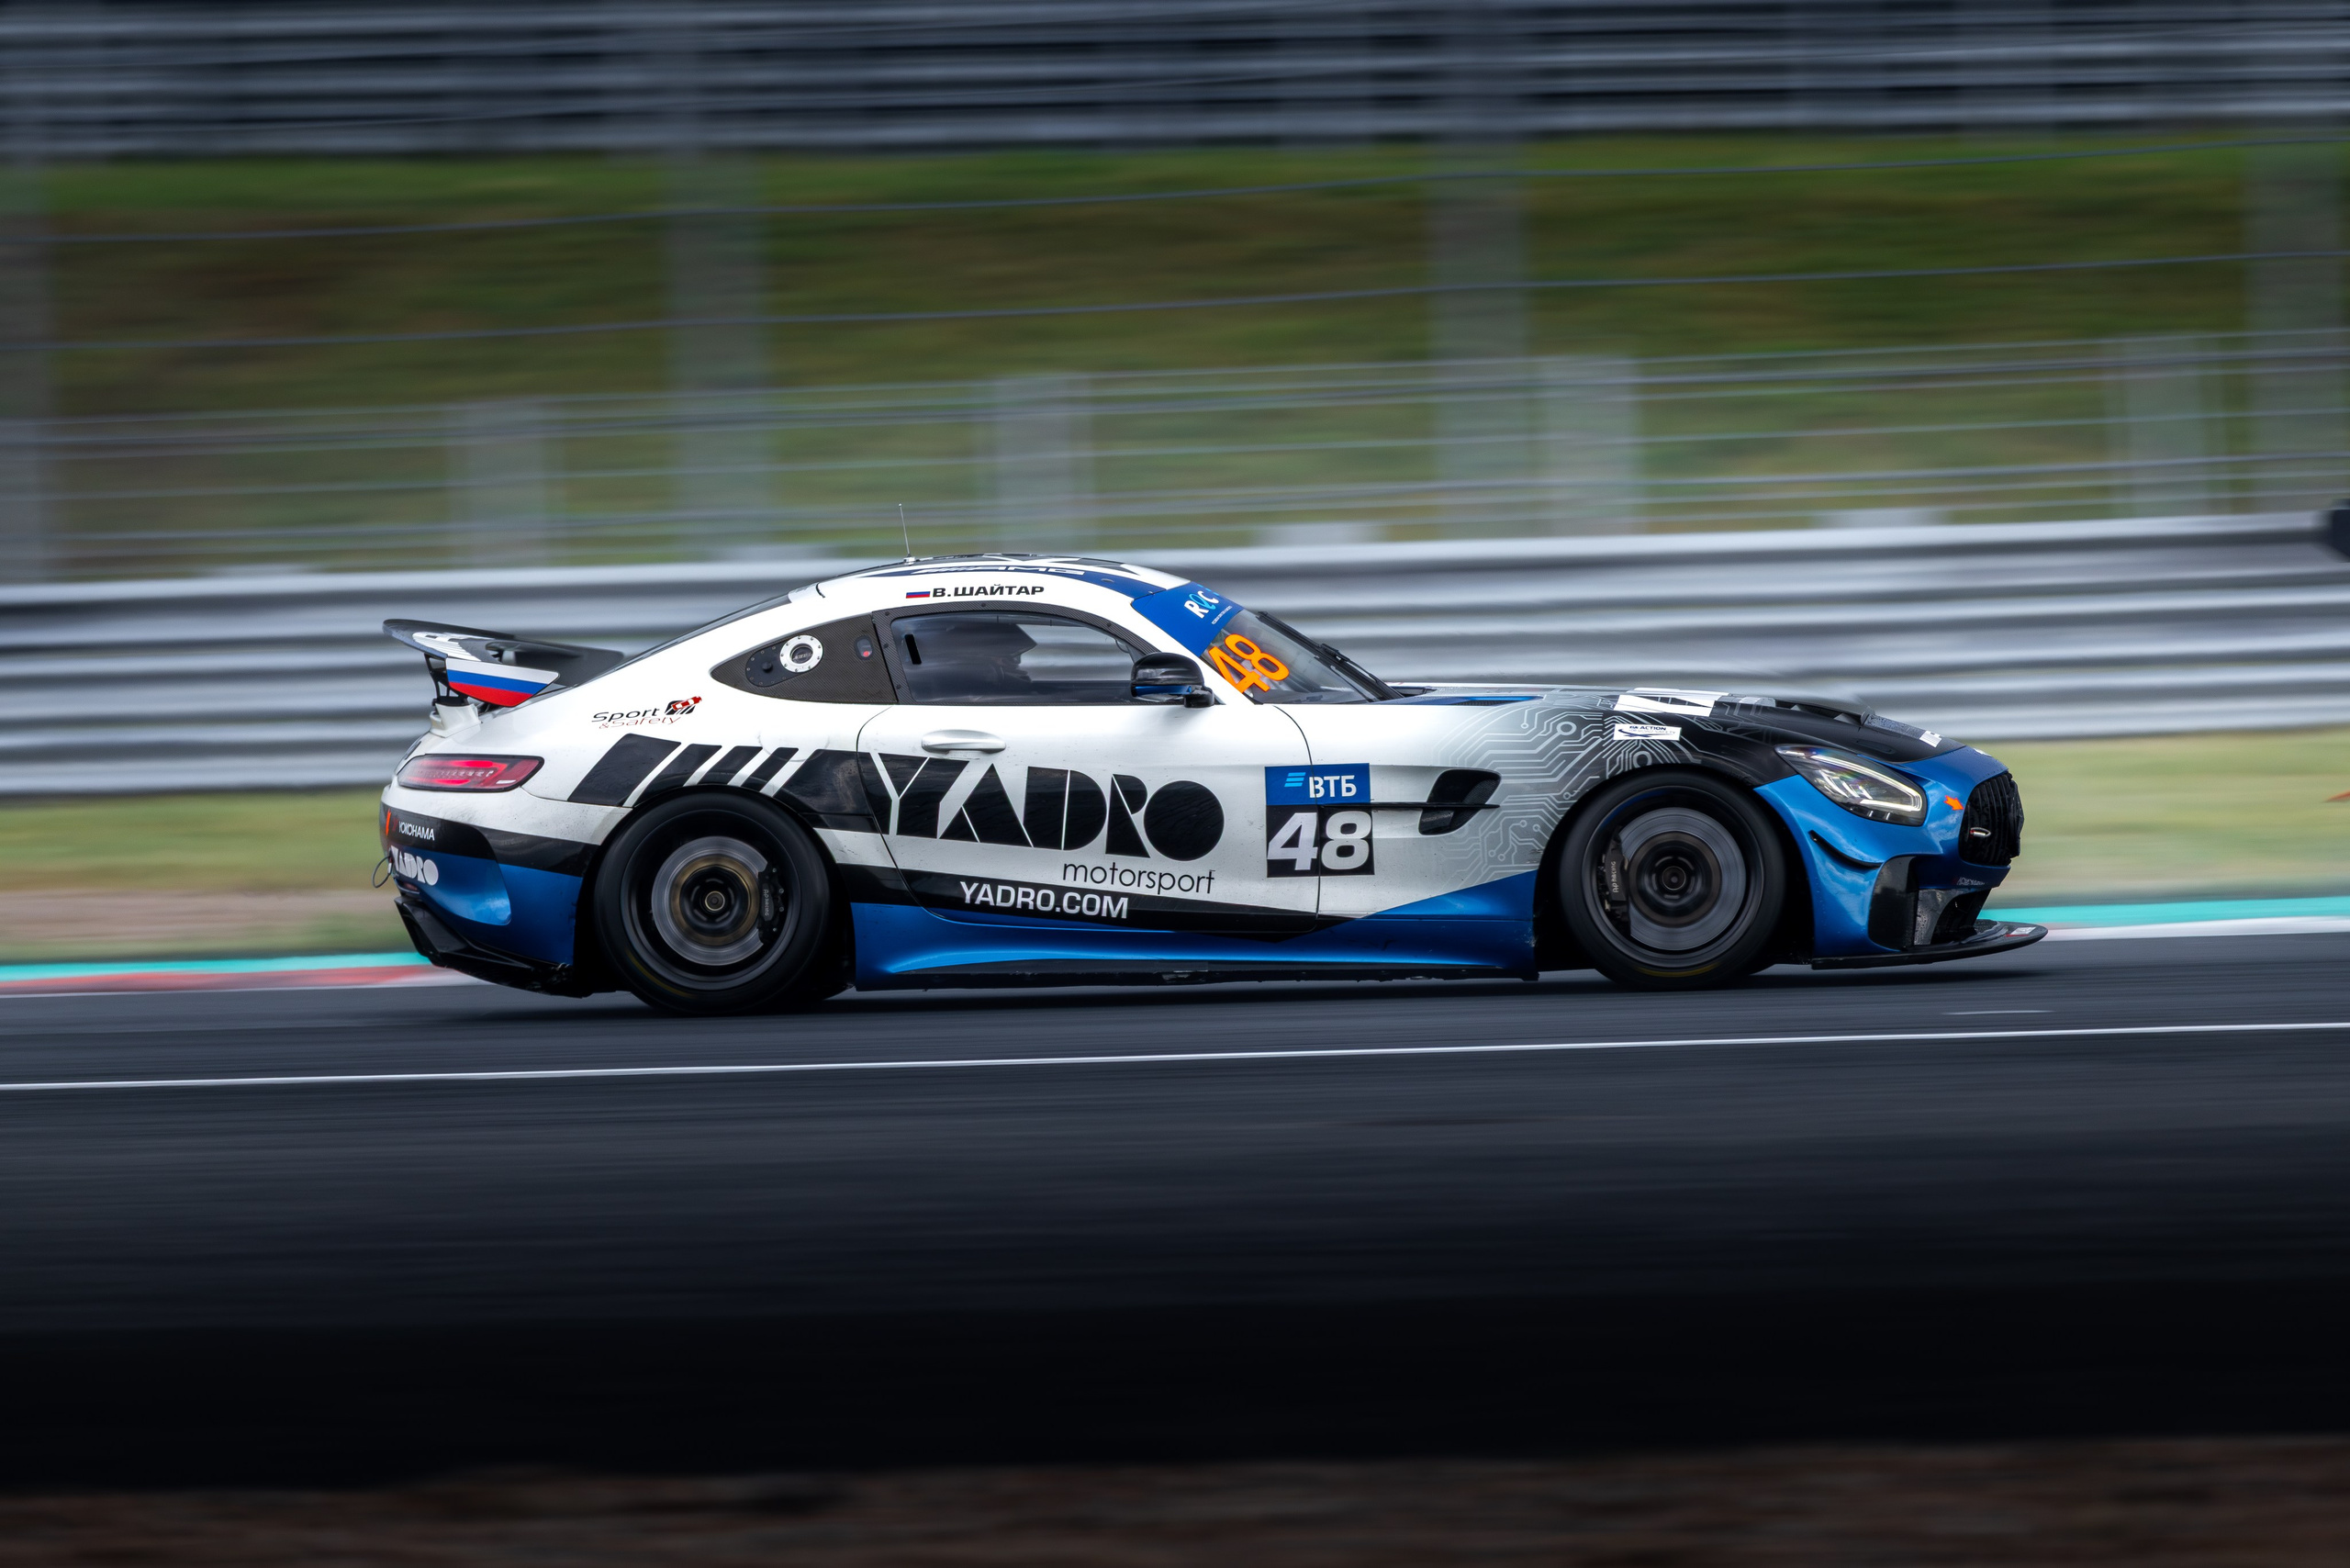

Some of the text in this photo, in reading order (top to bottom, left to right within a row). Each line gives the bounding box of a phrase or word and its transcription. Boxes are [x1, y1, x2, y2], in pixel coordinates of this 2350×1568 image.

[932, 583, 1046, 598] В.ШАЙТАР
[1208, 633, 1290, 694] 48
[591, 708, 661, 722] Sport
[1308, 775, 1358, 799] ВТБ
[878, 752, 1225, 861] YADRO
[398, 820, 435, 841] YOKOHAMA
[1267, 810, 1372, 871] 48
[1062, 862, 1215, 895] motorsport
[959, 880, 1129, 919] YADRO.COM
